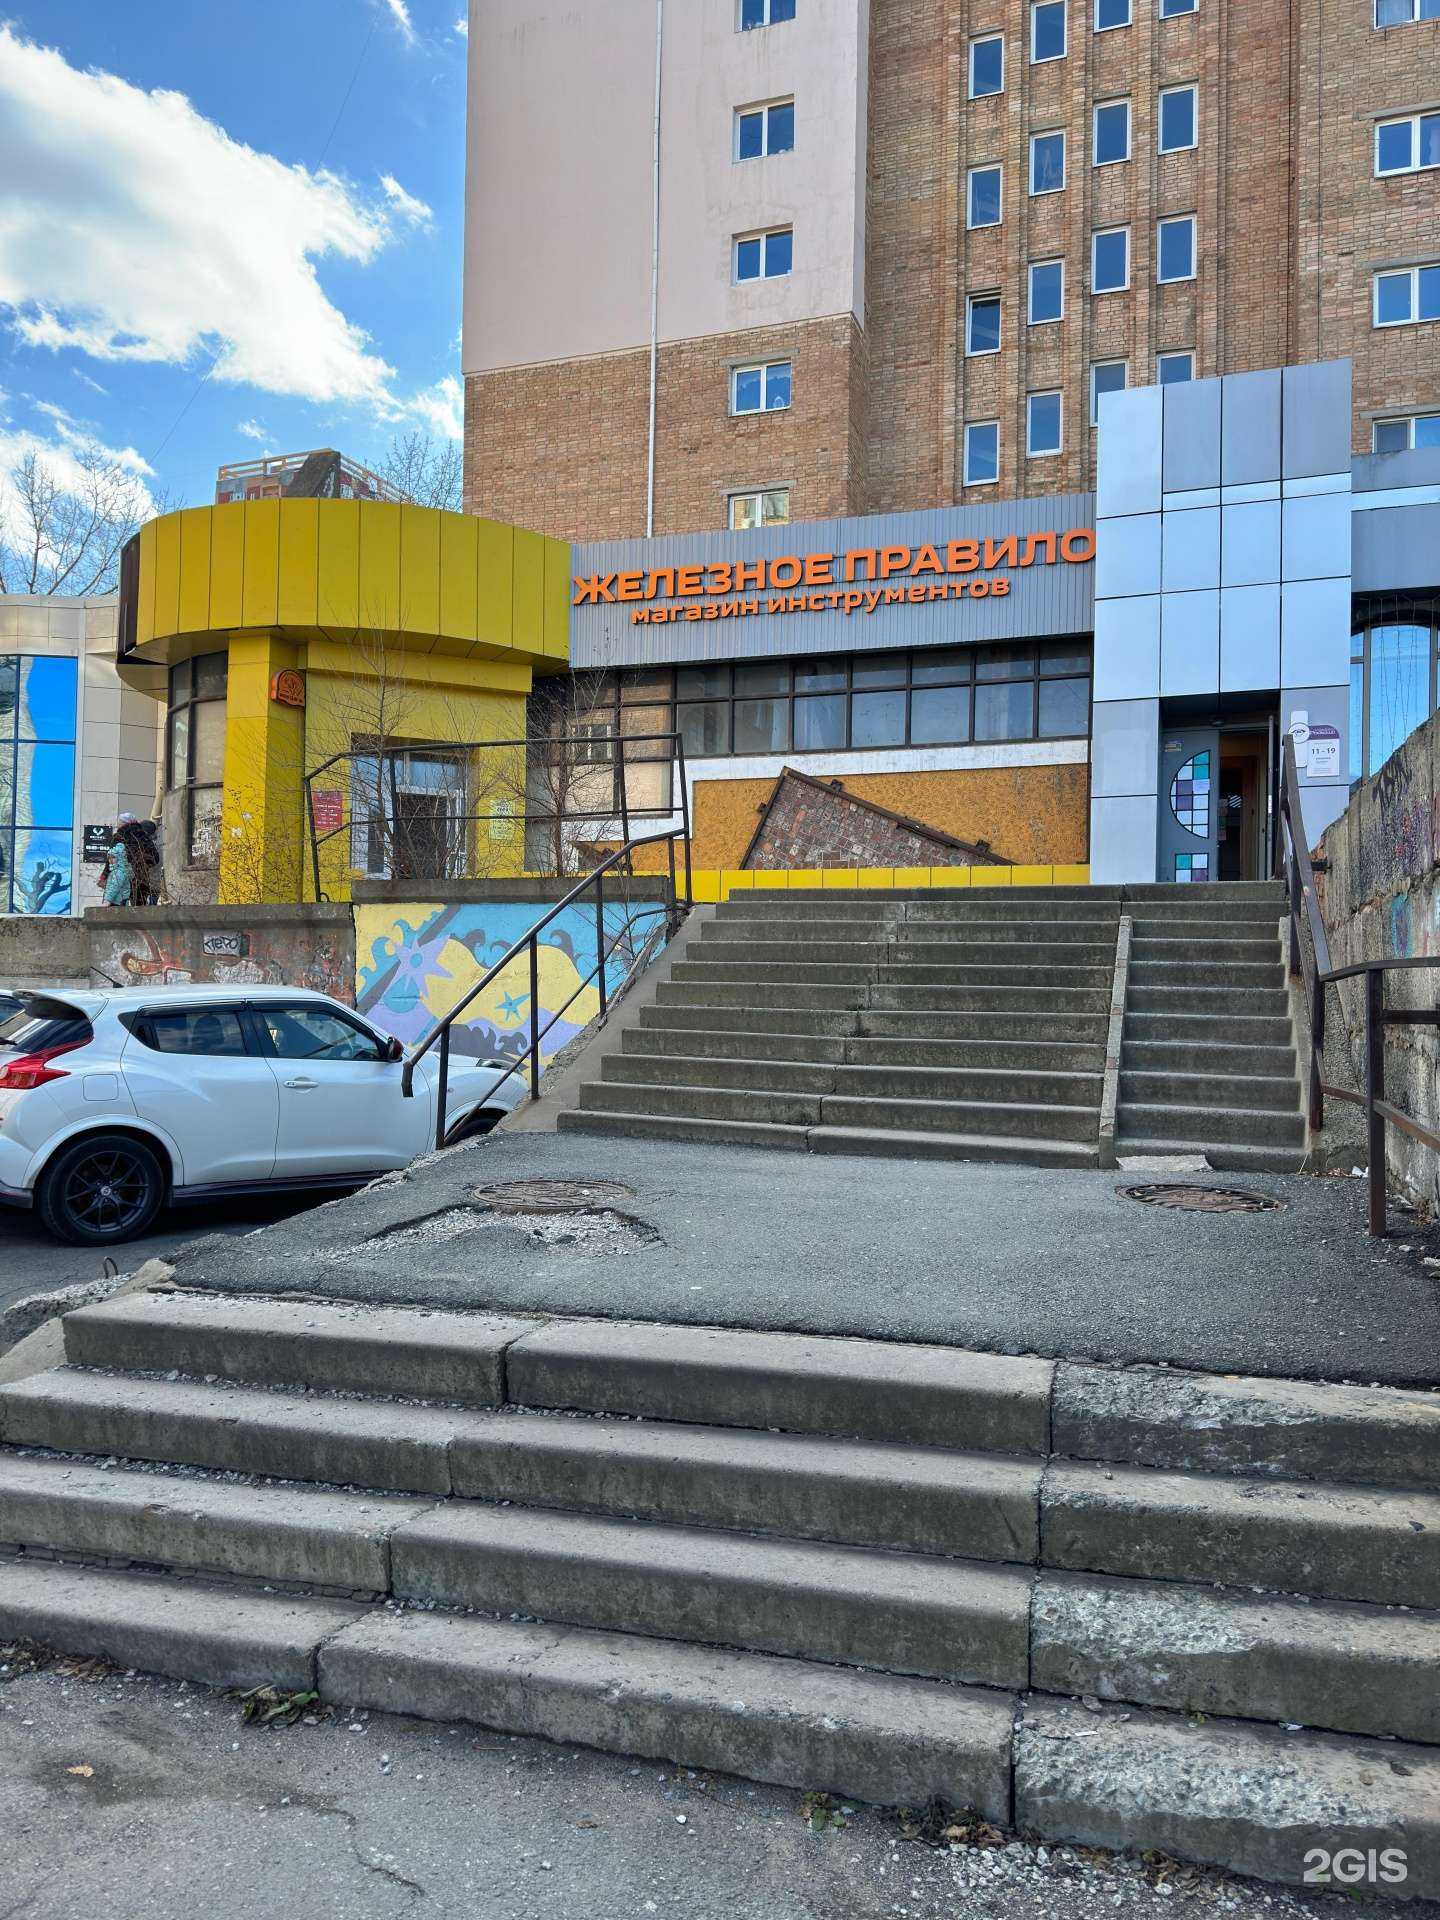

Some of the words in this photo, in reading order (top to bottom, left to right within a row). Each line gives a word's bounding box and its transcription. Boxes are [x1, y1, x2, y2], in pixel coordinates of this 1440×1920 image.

[572, 552, 834, 606] ЖЕЛЕЗНОЕ
[843, 528, 1096, 582] ПРАВИЛО
[631, 599, 760, 625] магазин
[767, 577, 1010, 616] инструментов
